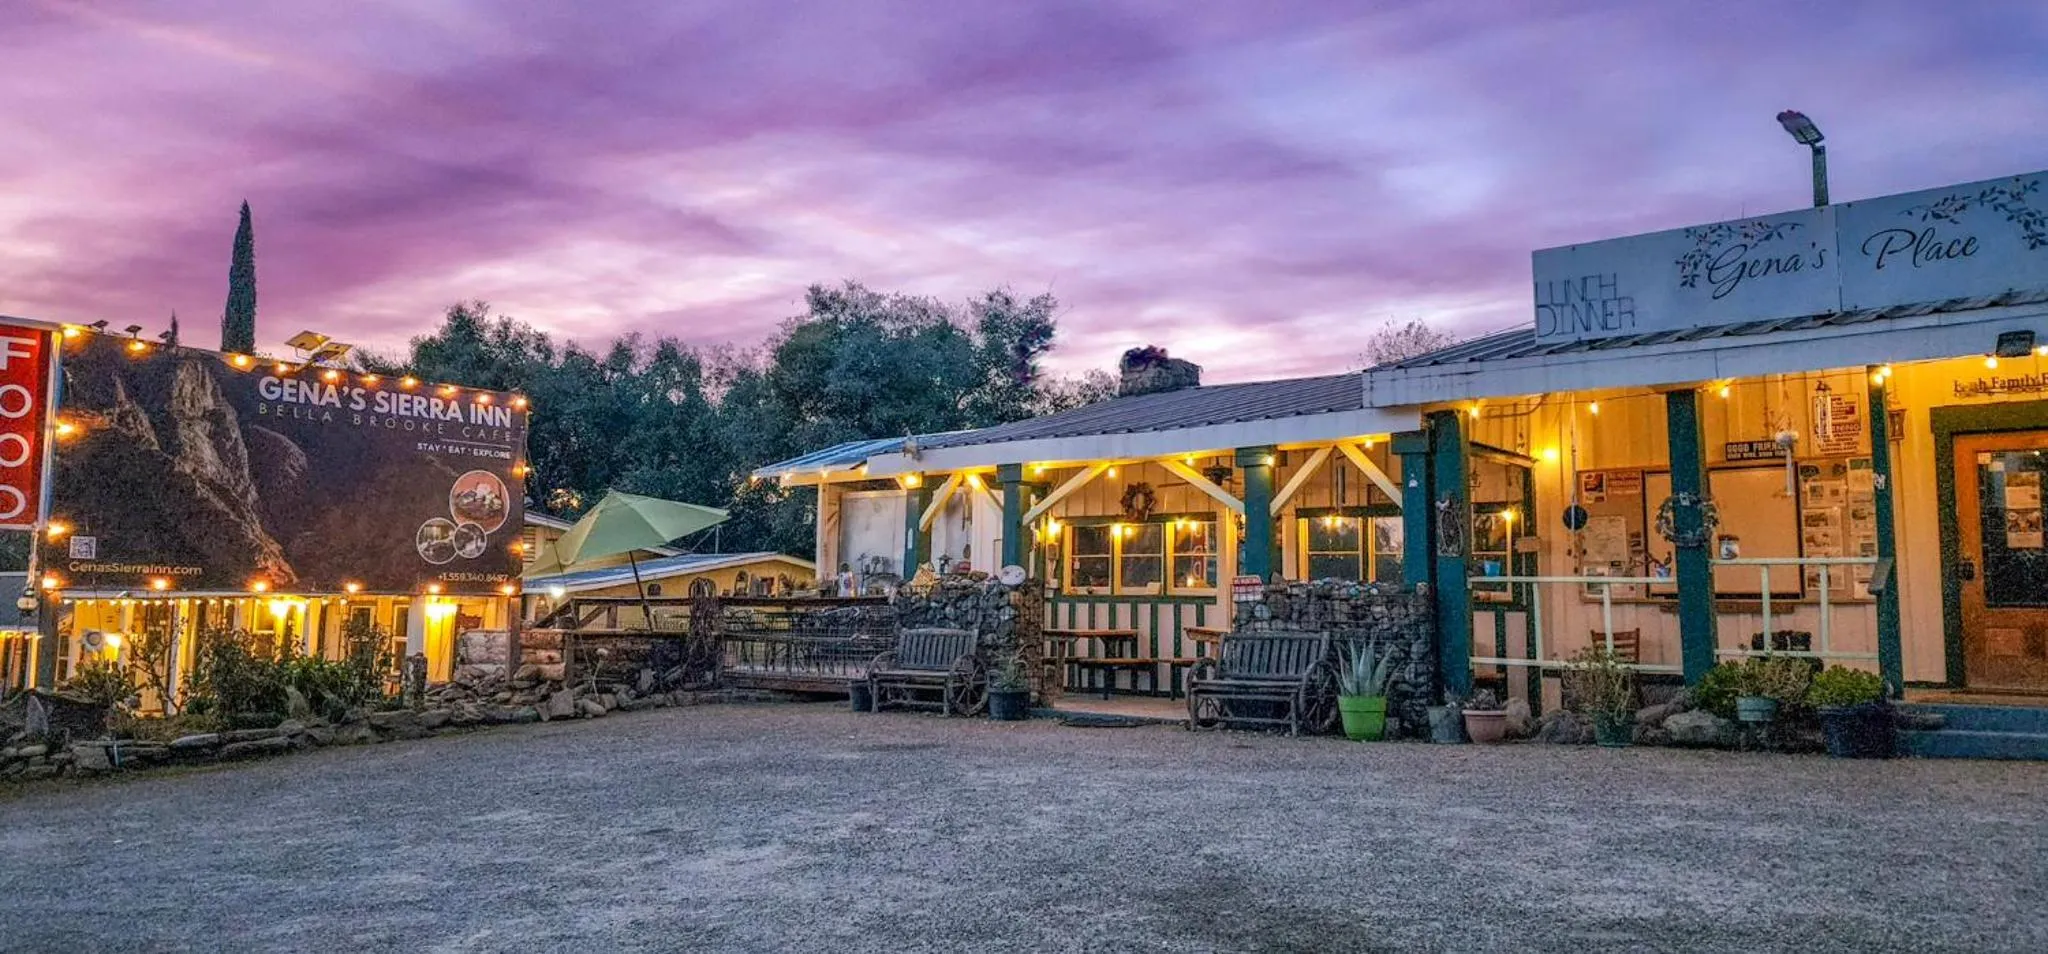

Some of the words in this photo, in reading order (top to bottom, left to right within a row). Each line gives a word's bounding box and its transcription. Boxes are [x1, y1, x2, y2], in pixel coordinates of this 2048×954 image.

[1706, 244, 1827, 299] Gena's
[1862, 227, 1979, 269] Place
[1535, 273, 1616, 307] LUNCH
[1536, 296, 1635, 337] DINNER
[258, 402, 333, 423] BELLA
[352, 414, 446, 435] BROOKE
[462, 426, 512, 441] CAFE
[259, 376, 366, 411] GENA'S
[373, 390, 463, 422] SIERRA
[470, 403, 512, 428] INN
[417, 442, 440, 452] STAY
[448, 445, 466, 454] EAT
[473, 448, 511, 459] EXPLORE
[68, 561, 203, 575] GenasSierraInn.com
